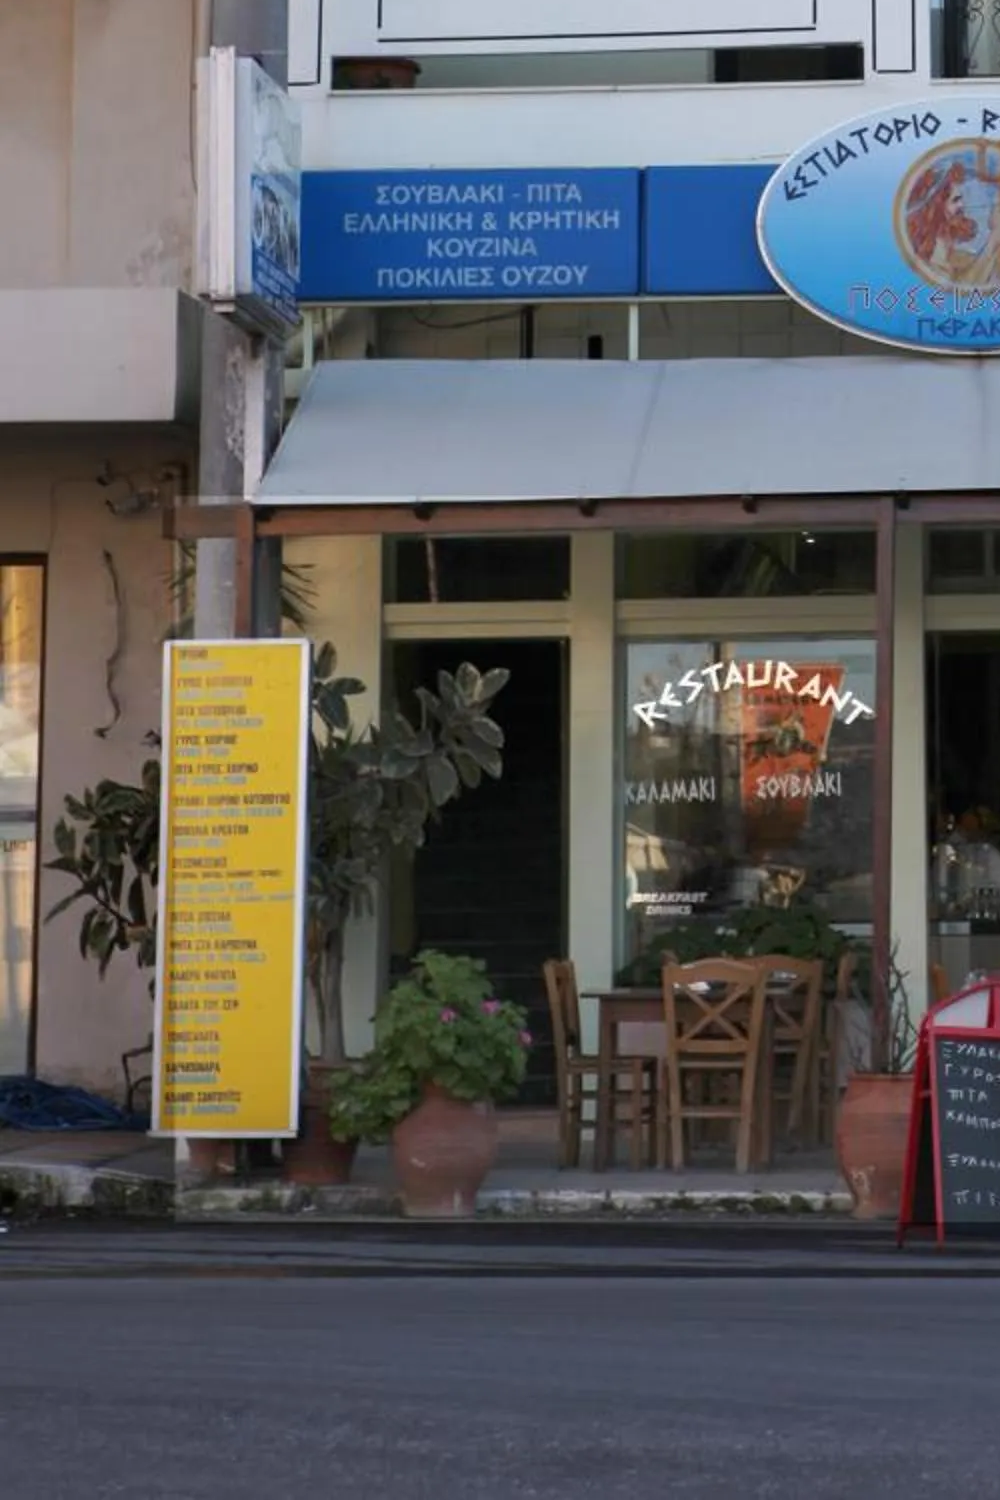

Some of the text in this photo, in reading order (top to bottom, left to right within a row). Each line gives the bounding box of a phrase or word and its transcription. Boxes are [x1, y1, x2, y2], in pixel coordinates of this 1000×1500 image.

[784, 111, 942, 201] ΕΣΤΙΑΤΟΡΙΟ
[376, 185, 504, 206] ΣΟΥΒΛΑΚΙ
[528, 184, 582, 203] ΠΙΤΑ
[344, 210, 620, 233] ΕΛΛΗΝΙΚΗ & ΚΡΗΤΙΚΗ
[427, 238, 538, 258] ΚΟΥΖΙΝΑ
[378, 265, 589, 288] ΠΟΚΙΛΙΕΣ ΟΥΖΟΥ
[632, 660, 875, 728] RESTAURANT
[625, 772, 842, 803] ΚΑΛΑΜΑΚΙ ΣΟΥΒΛΑΚΙ
